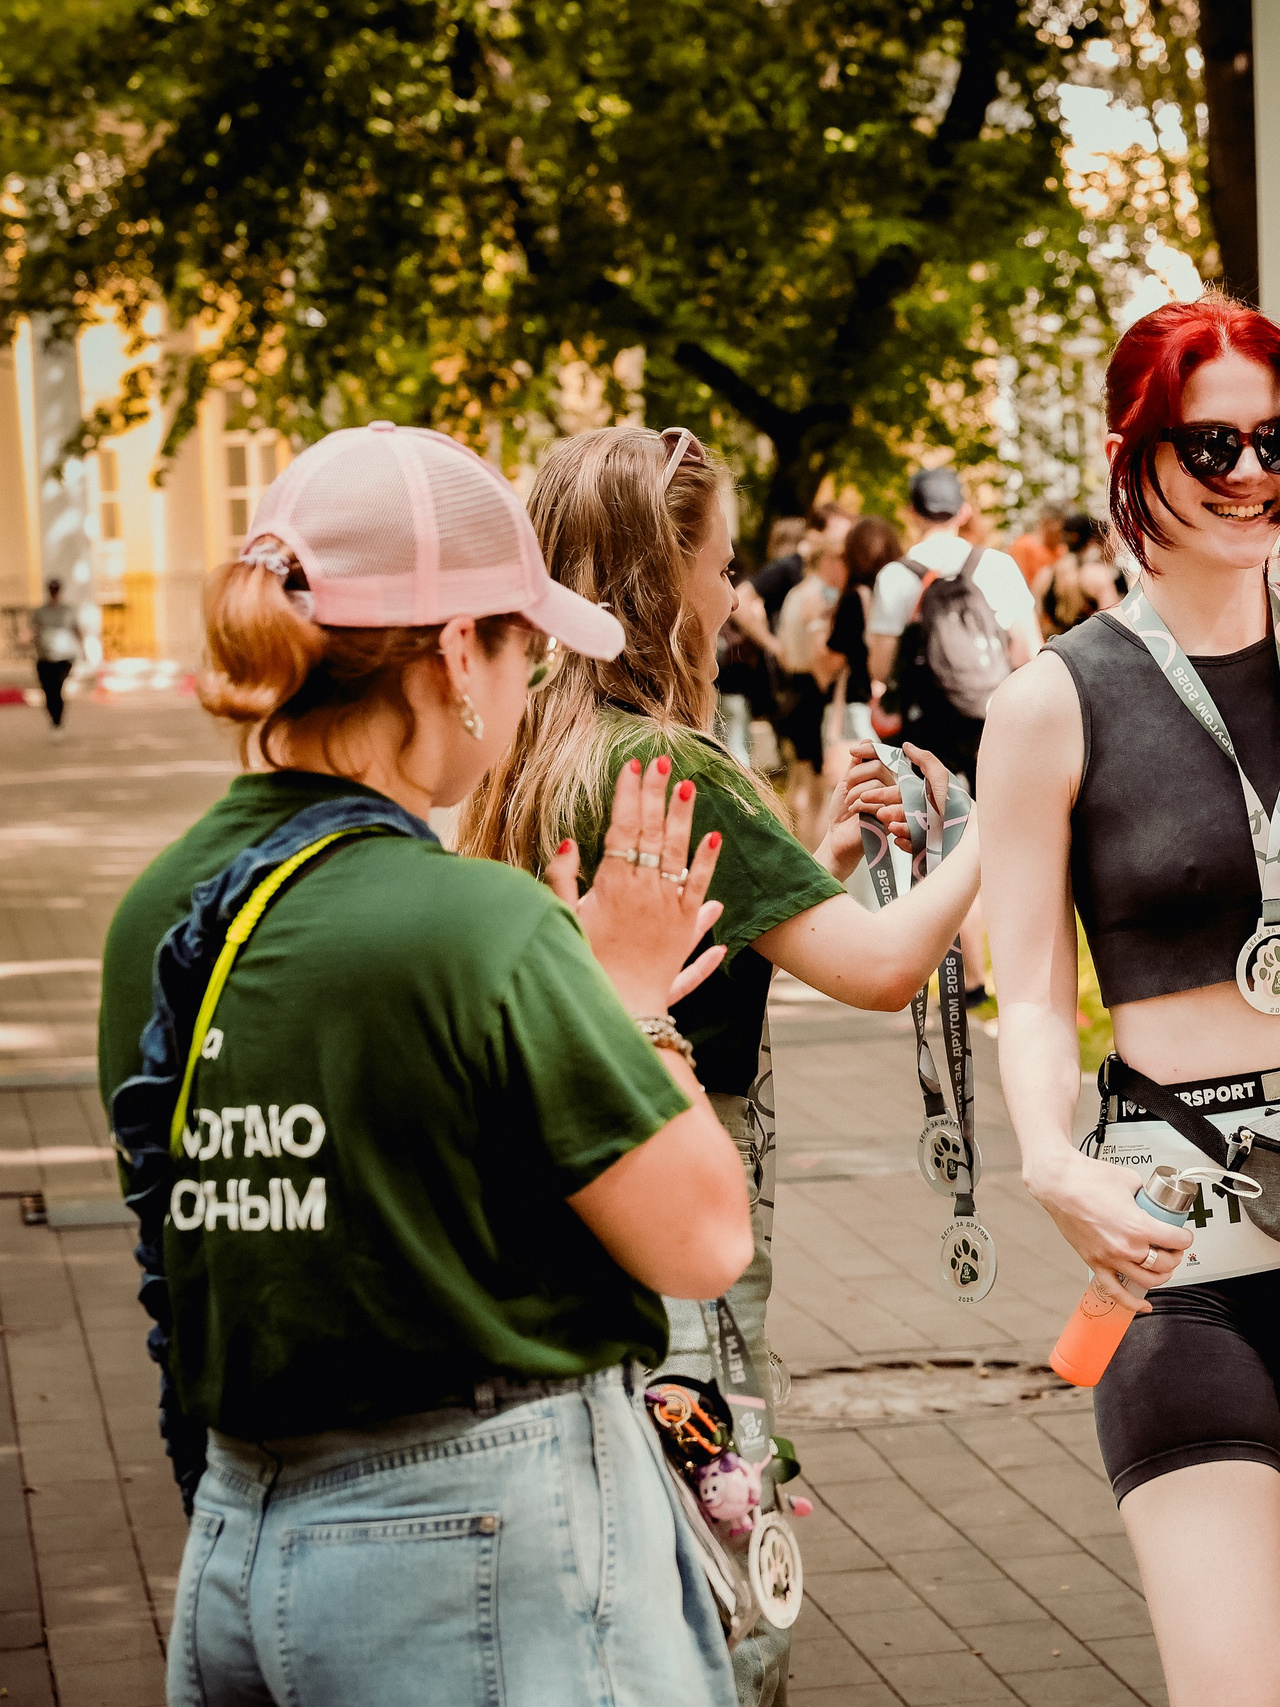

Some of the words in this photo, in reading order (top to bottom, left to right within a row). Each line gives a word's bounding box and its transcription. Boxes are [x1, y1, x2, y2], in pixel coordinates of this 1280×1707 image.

[1172, 666, 1200, 702] 2026
[1195, 701, 1236, 756] ДРУГОМ
[877, 869, 893, 904] 2026
[1246, 932, 1264, 951] БЕГИ
[1266, 927, 1277, 935] ЗА
[945, 957, 959, 994] 2026
[947, 998, 963, 1058] ДРУГОМ
[954, 1061, 962, 1081] ЗА
[955, 1085, 963, 1120] ГИ
[182, 1103, 326, 1161] ОГАЮ
[940, 1119, 960, 1130] ДРУГ
[940, 1225, 955, 1241] БЕГИ
[965, 1221, 989, 1242] ДРУГОМ
[767, 1350, 783, 1365] ГОМ
